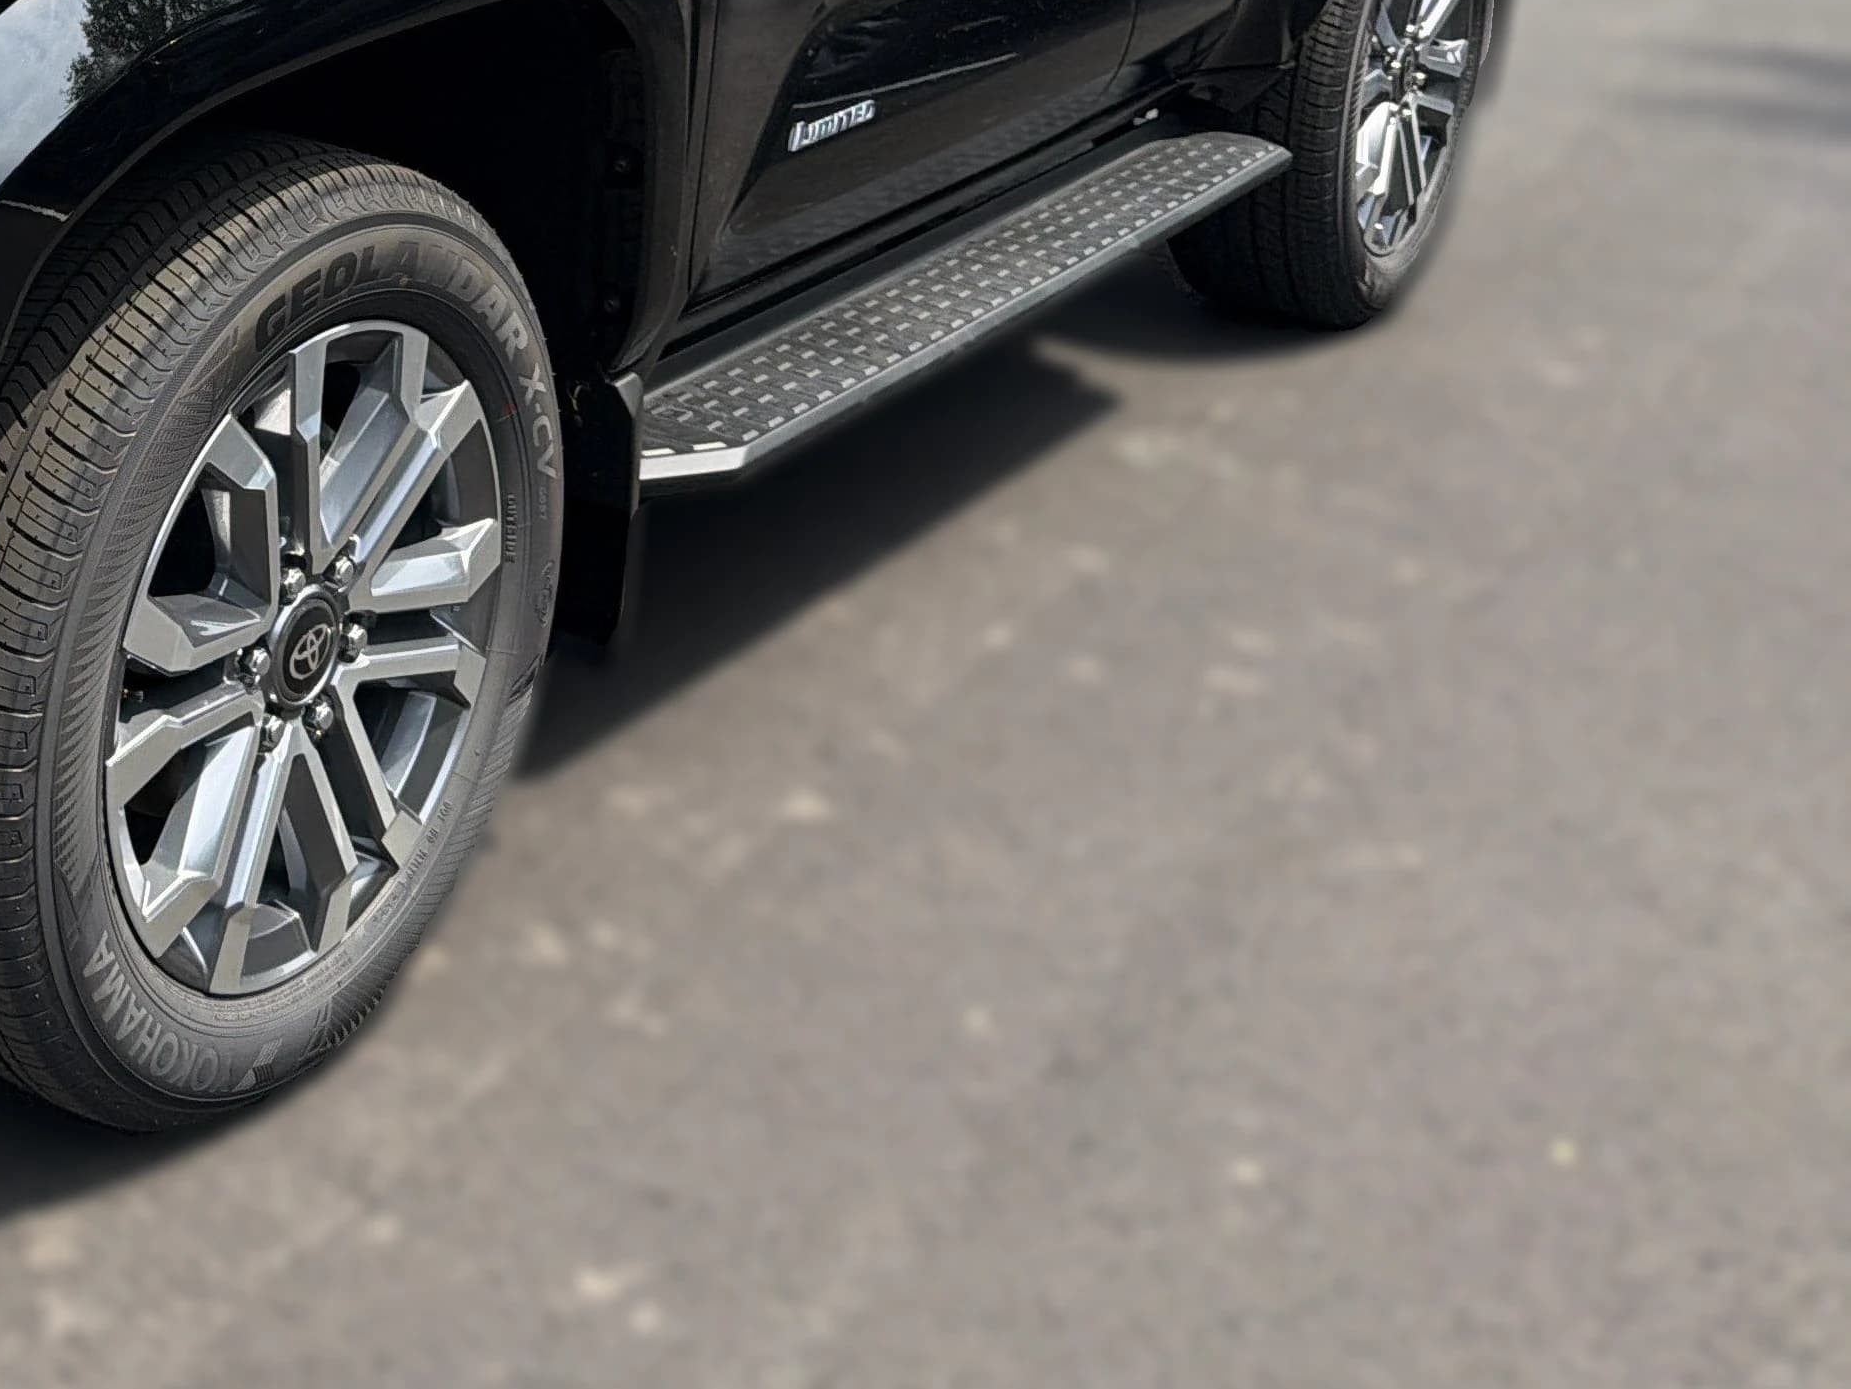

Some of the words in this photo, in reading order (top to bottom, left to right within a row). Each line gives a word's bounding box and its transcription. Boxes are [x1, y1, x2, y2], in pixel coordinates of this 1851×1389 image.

[787, 99, 876, 152] LIMITED
[255, 241, 530, 361] GEOLANDAR
[519, 363, 559, 479] X-CV
[504, 494, 517, 564] OUTSIDE
[83, 930, 233, 1093] YOKOHAMA
